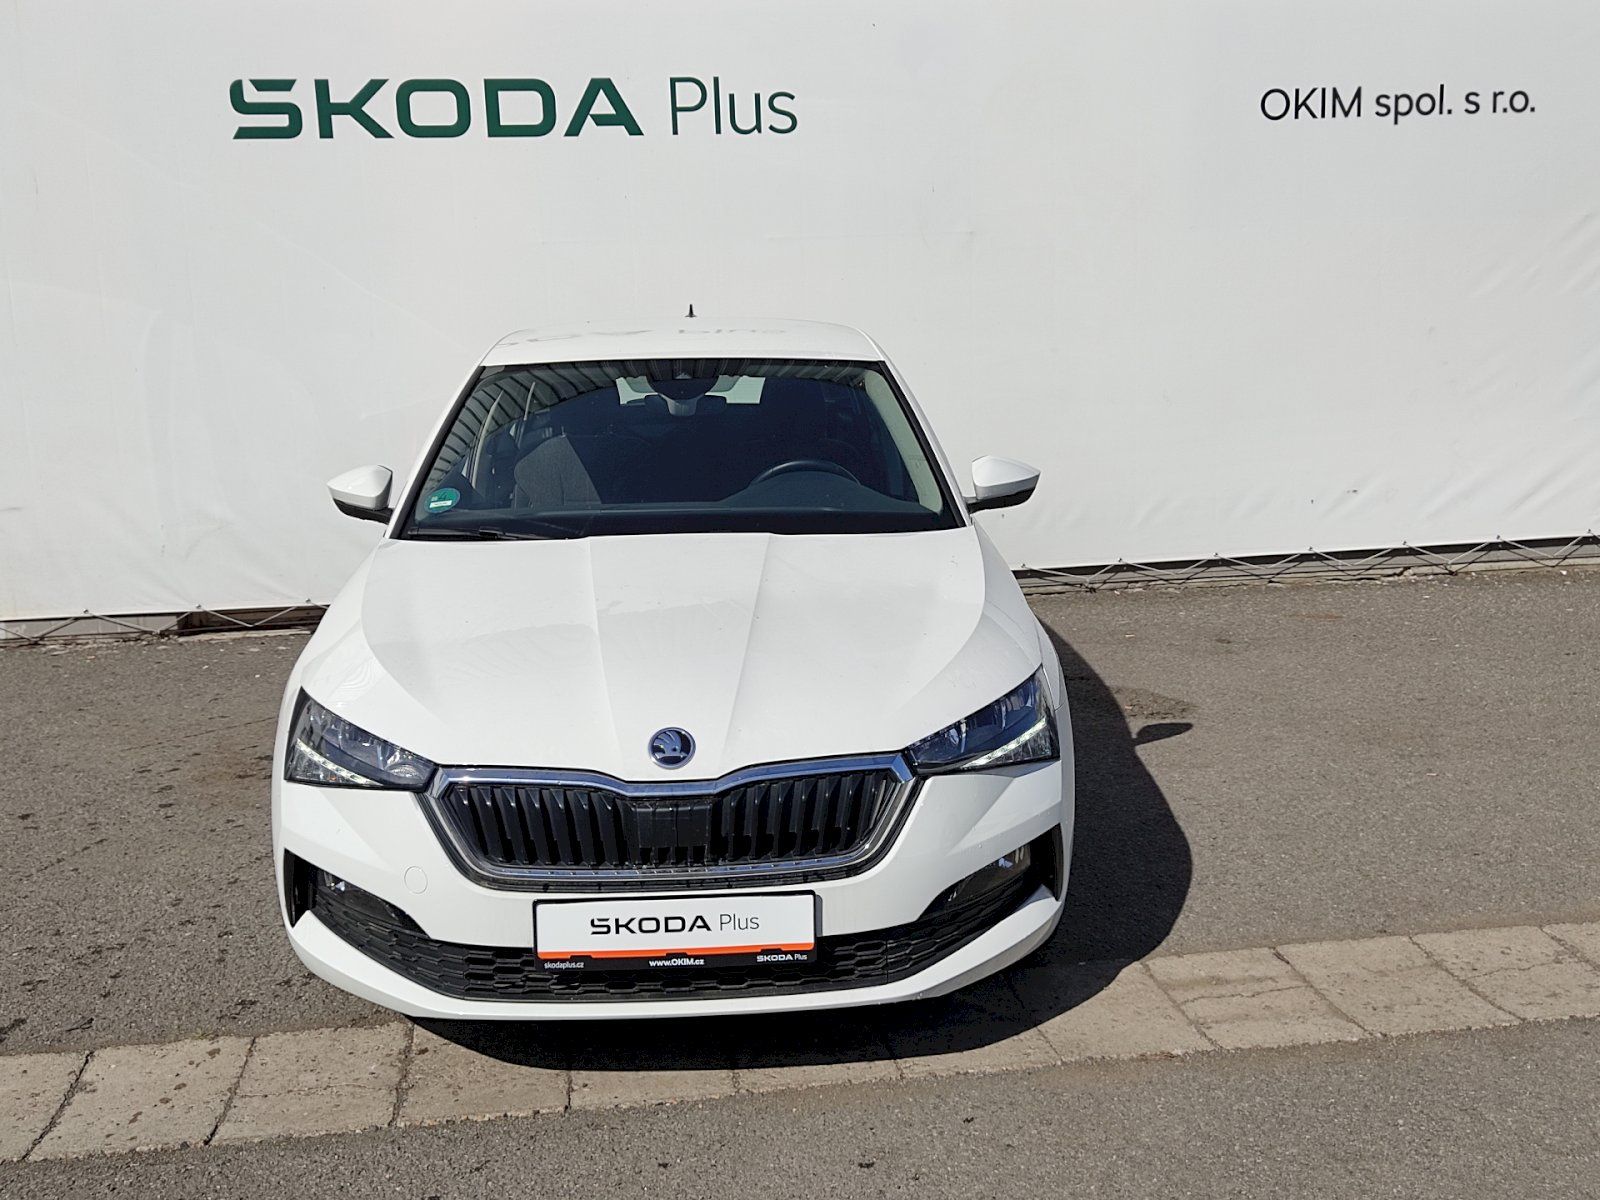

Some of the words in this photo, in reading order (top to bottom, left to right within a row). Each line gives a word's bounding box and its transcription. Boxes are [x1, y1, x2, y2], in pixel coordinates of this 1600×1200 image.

[669, 75, 798, 135] Plus
[1260, 86, 1363, 120] OKIM
[1374, 83, 1453, 125] spol.
[1463, 91, 1481, 115] s
[1491, 90, 1536, 114] r.o.
[719, 912, 760, 932] Plus
[648, 957, 705, 967] www.OKIM.cz
[794, 953, 808, 961] Plus
[543, 961, 586, 970] skodaplus.cz
